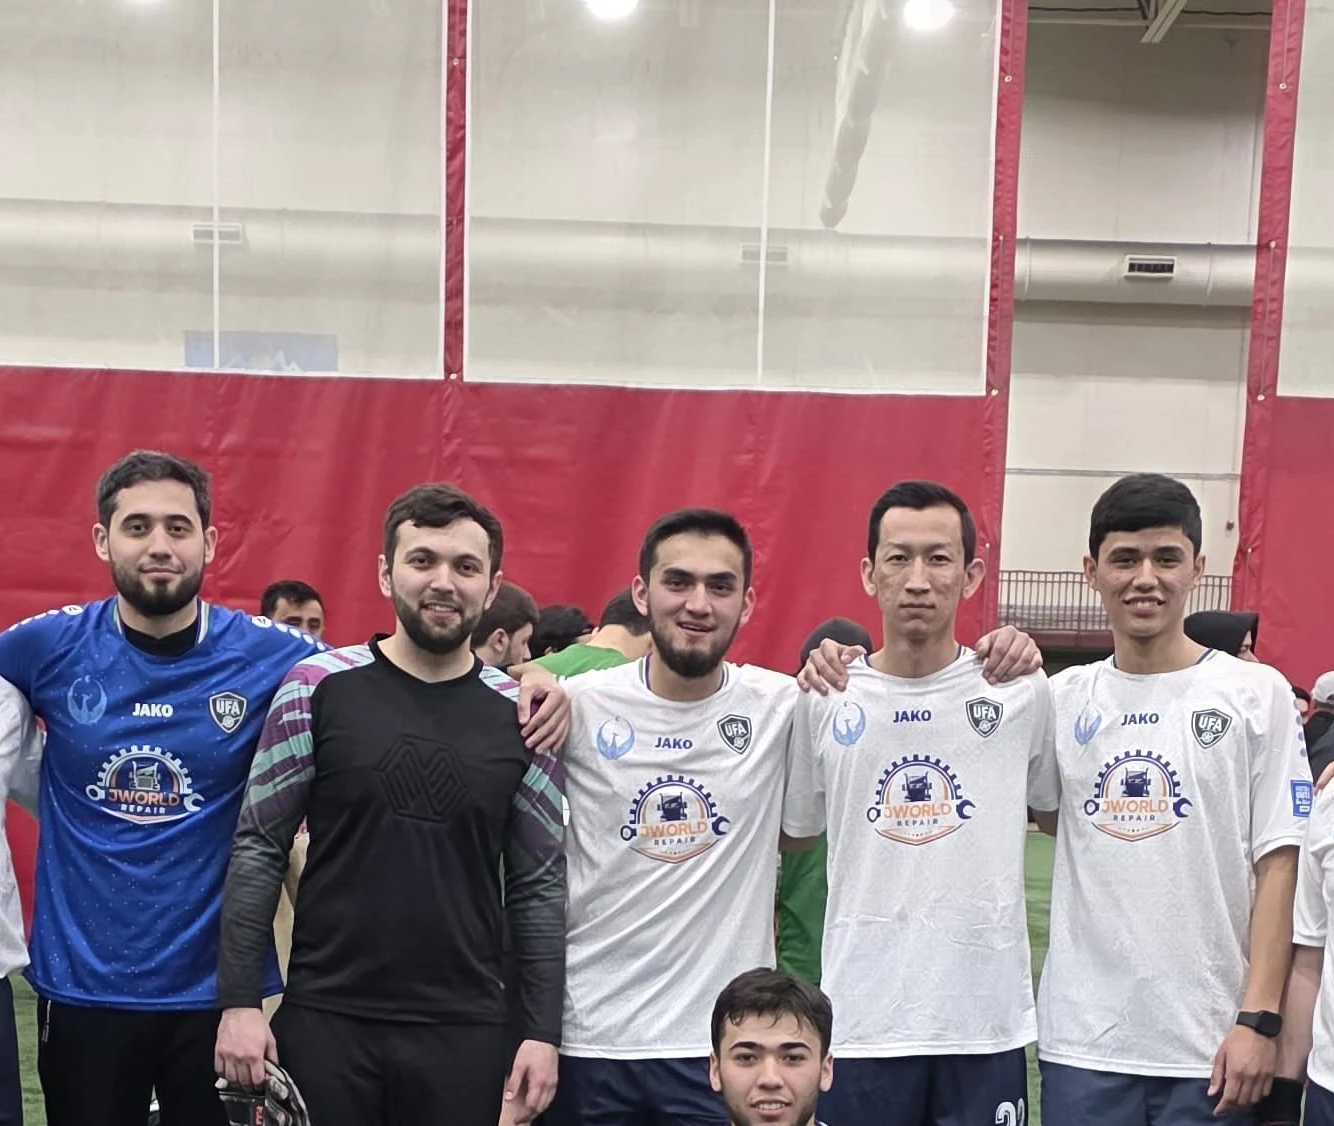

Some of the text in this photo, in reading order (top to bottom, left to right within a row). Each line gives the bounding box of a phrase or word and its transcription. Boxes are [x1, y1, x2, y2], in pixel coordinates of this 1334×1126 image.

[132, 703, 174, 718] JAKO
[216, 700, 241, 717] UFA
[973, 706, 996, 720] UFA
[893, 709, 932, 723] JAKO
[1121, 712, 1160, 726] JAKO
[724, 721, 747, 736] UFA
[1199, 715, 1223, 733] UFA
[654, 736, 693, 750] JAKO
[108, 789, 181, 806] JWORLD
[120, 804, 166, 815] REPAIR
[884, 803, 952, 819] JWORLD
[1102, 800, 1169, 814] JWORLD
[896, 818, 939, 827] REPAIR
[1113, 814, 1156, 822] REPAIR
[640, 821, 709, 838] JWORLD
[654, 836, 697, 846] REPAIR
